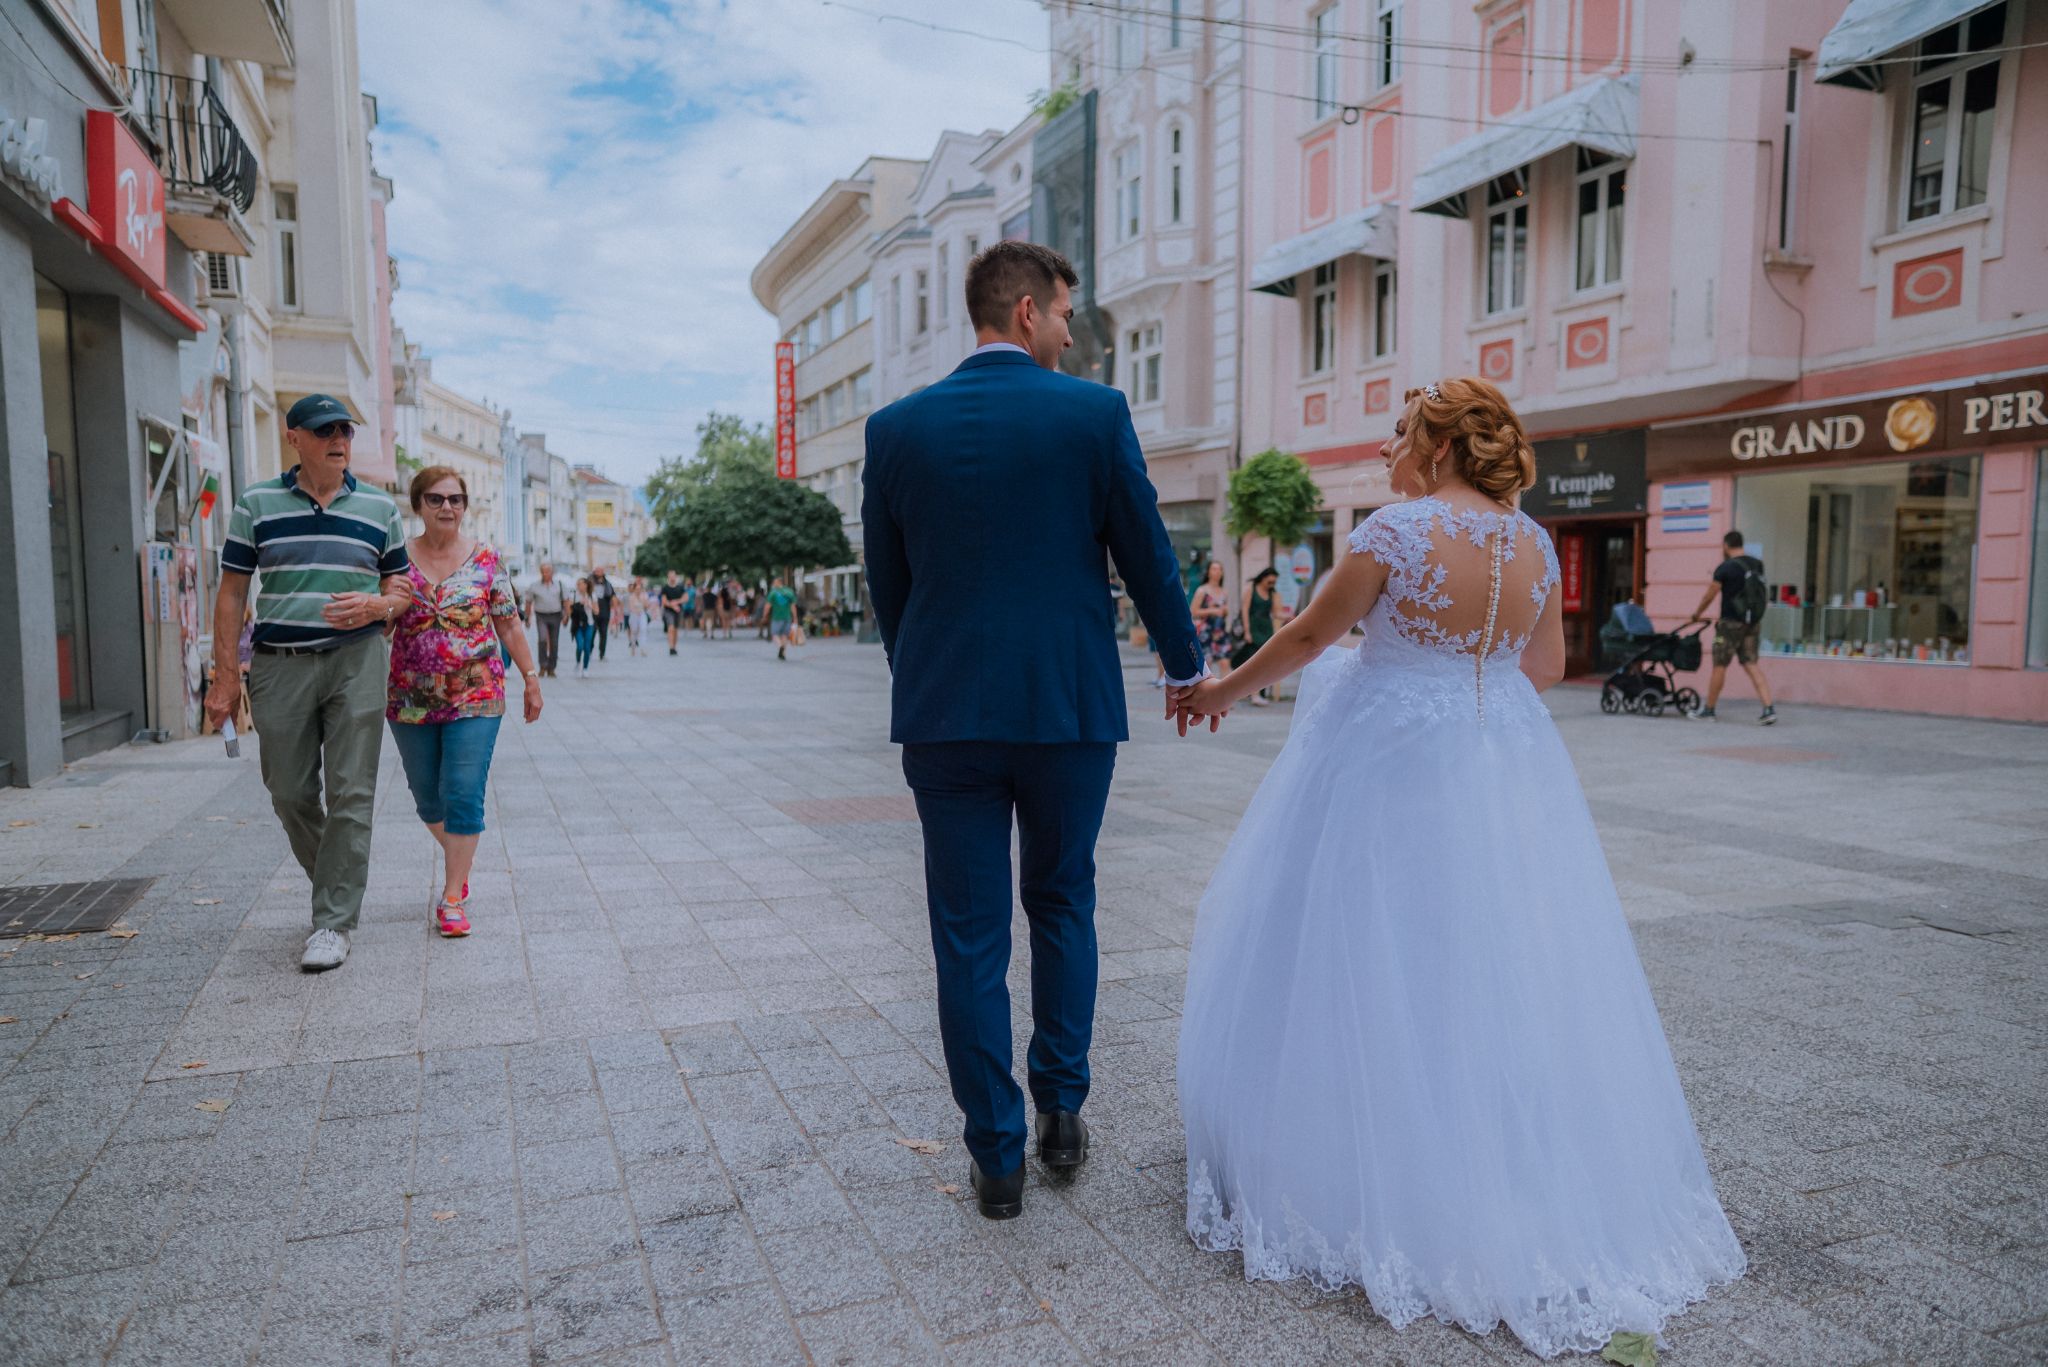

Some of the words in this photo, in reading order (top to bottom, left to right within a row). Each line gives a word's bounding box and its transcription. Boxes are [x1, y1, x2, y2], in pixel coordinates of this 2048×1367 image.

[1731, 415, 1865, 460] GRAND
[1963, 390, 2048, 434] PER
[1548, 472, 1615, 495] Temple
[1567, 496, 1592, 508] BAR
